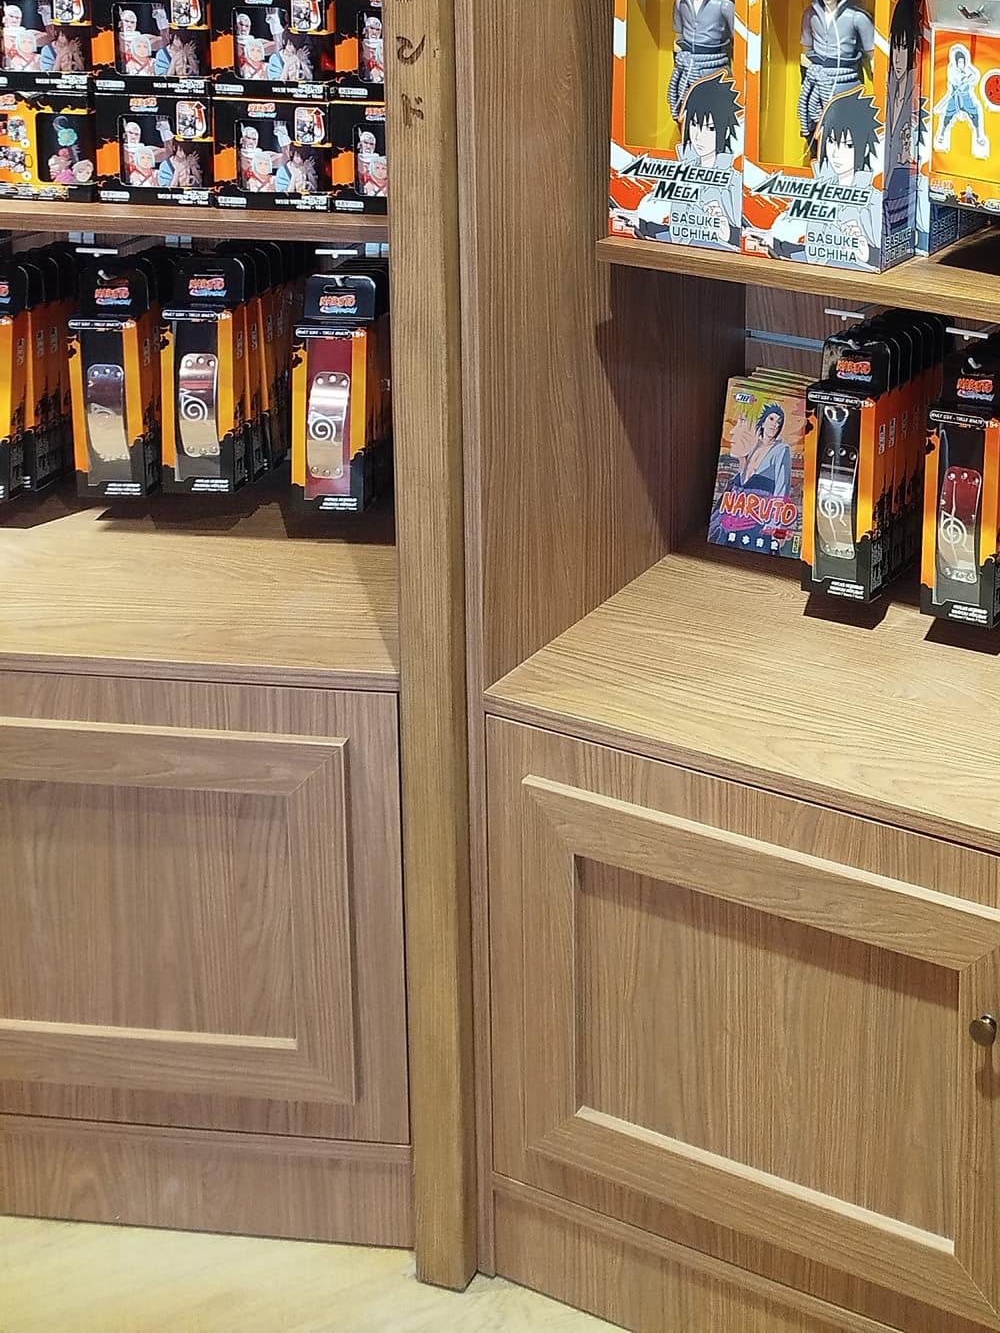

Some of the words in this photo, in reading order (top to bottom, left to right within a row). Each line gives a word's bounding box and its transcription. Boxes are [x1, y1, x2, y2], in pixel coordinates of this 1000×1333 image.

[653, 182, 700, 202] MEGA
[789, 199, 837, 220] MEGA
[671, 211, 721, 228] SASUKE
[672, 226, 719, 242] UCHIHA
[807, 231, 860, 249] SASUKE
[808, 246, 858, 264] UCHIHA
[720, 491, 798, 526] NARUTO
